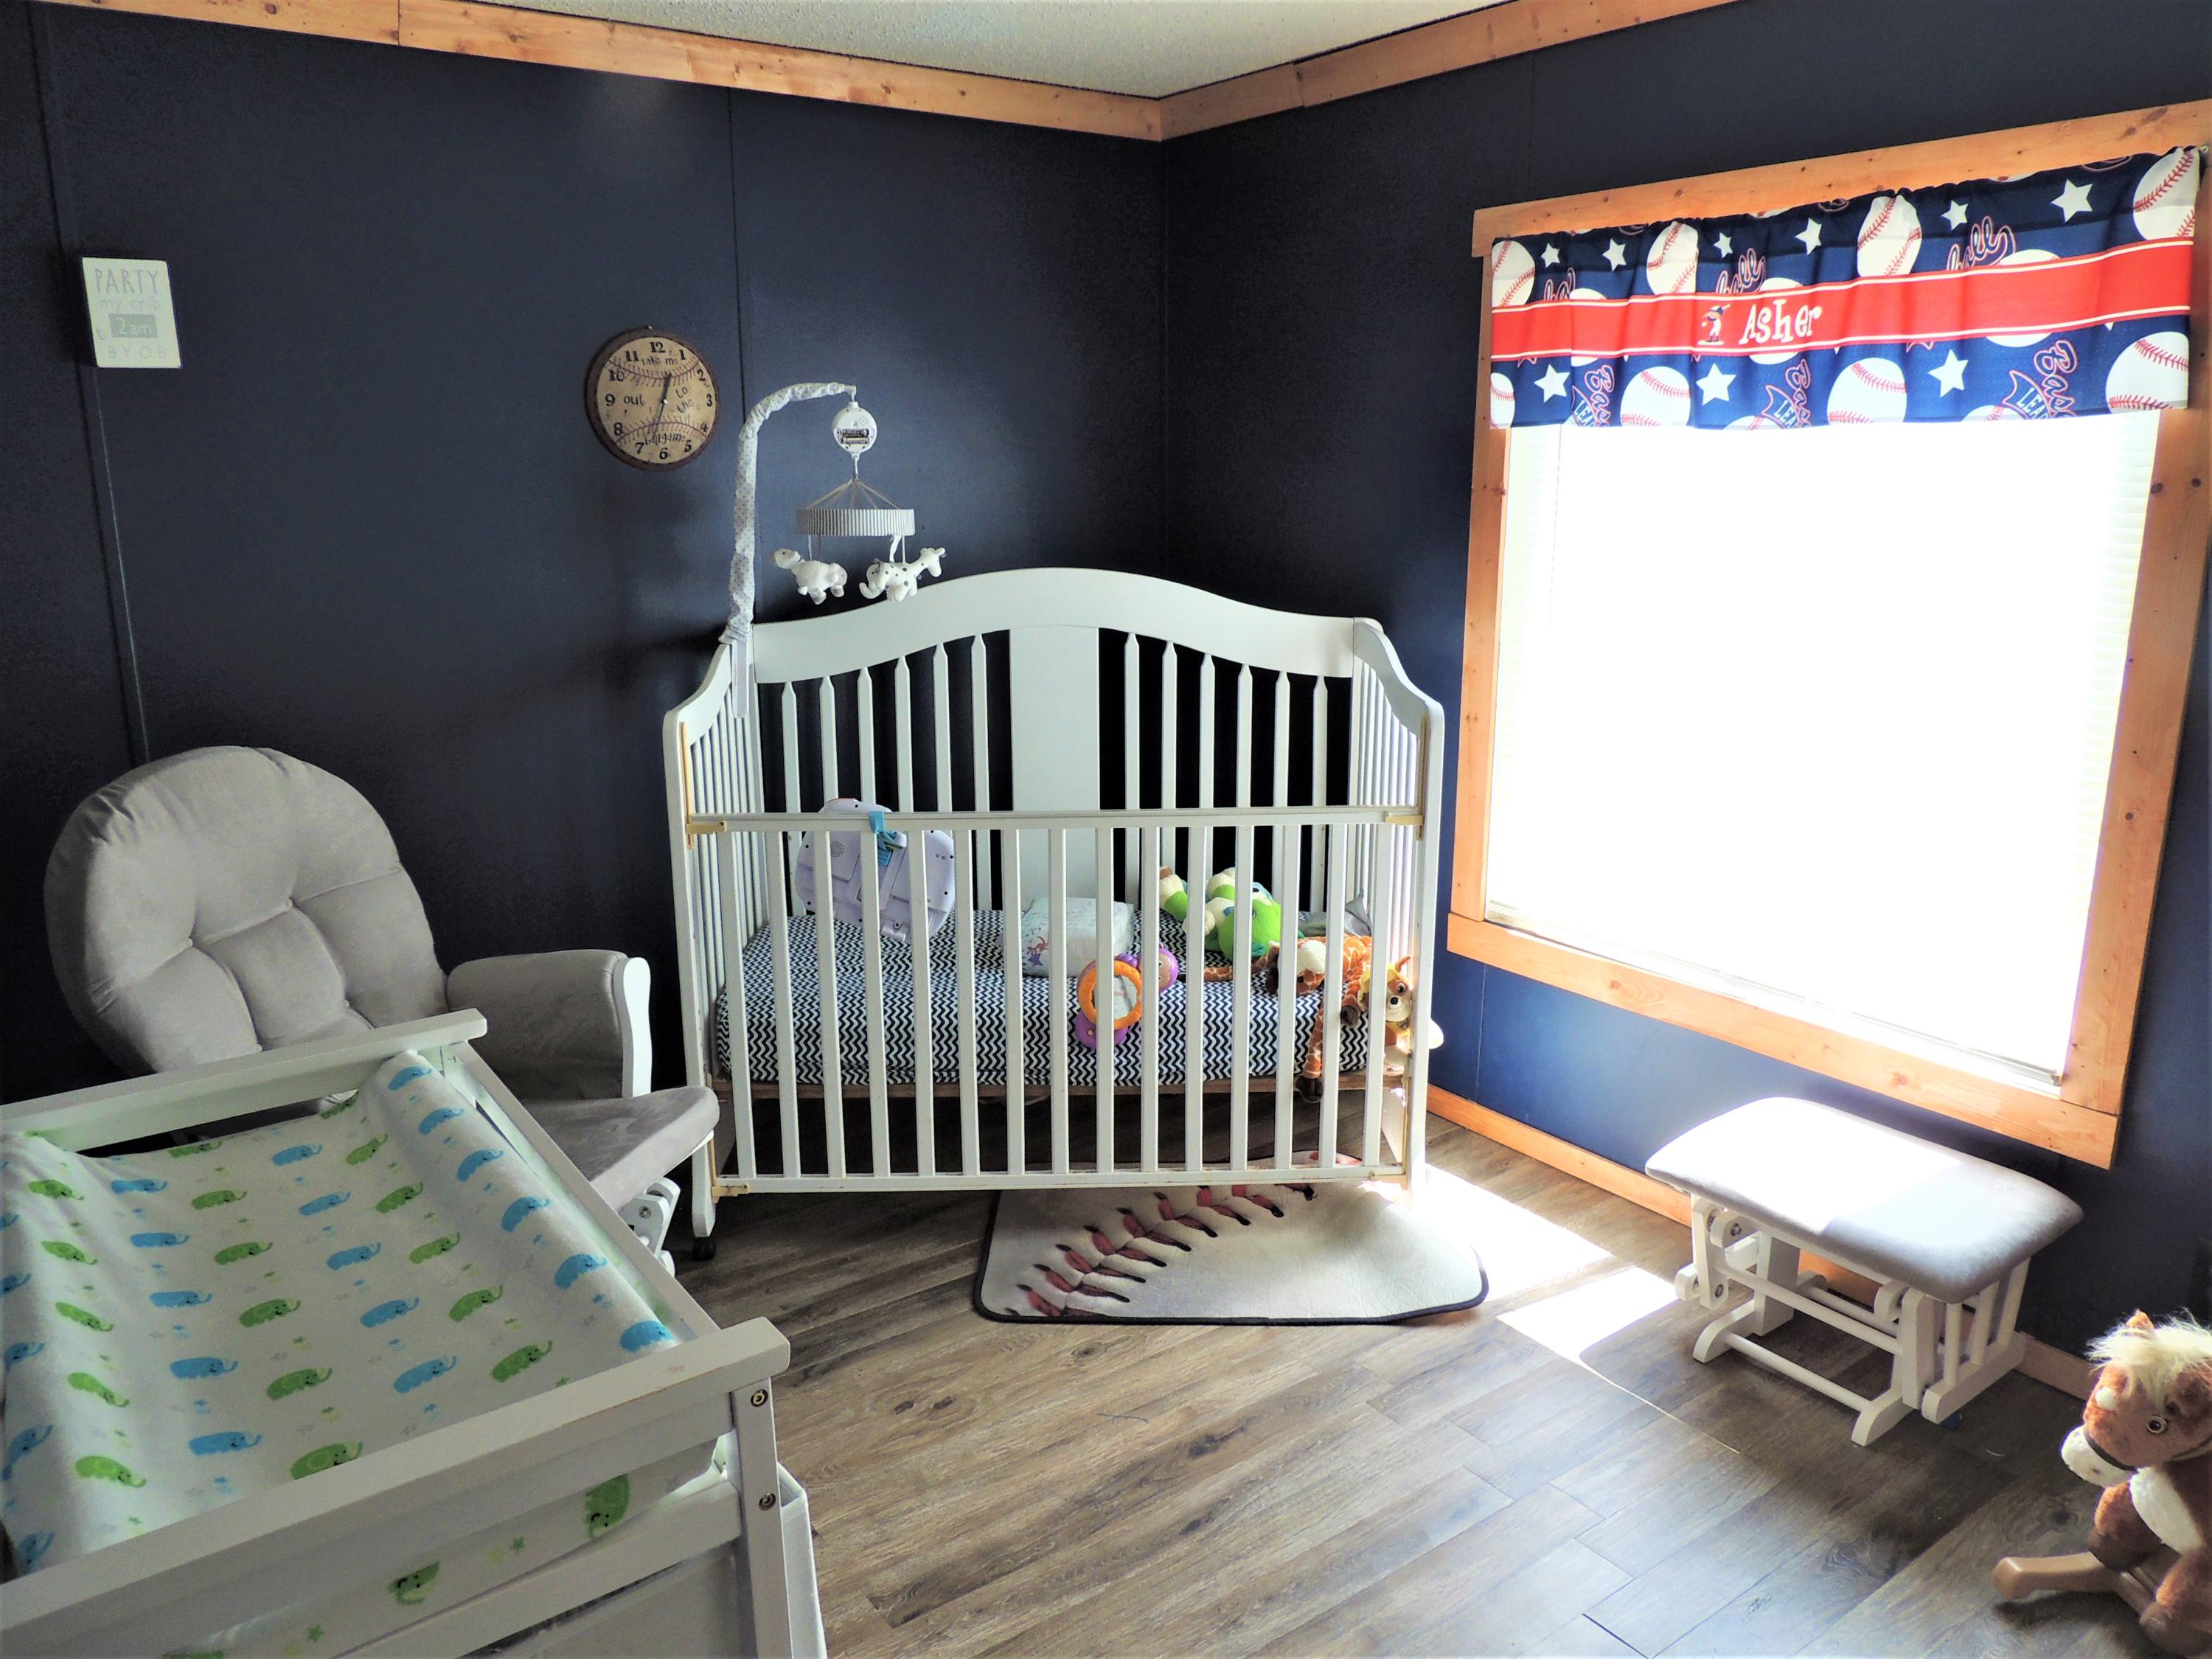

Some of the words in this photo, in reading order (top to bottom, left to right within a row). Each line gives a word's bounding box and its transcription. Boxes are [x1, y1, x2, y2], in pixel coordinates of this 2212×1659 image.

[94, 268, 159, 294] PARTY
[100, 299, 123, 313] my
[115, 317, 153, 335] 2am
[1738, 299, 1822, 345] Asher
[108, 345, 167, 360] BYOB
[650, 341, 666, 353] 12
[625, 350, 639, 362] 11
[641, 355, 661, 367] take
[665, 357, 678, 366] me
[678, 349, 686, 361] 1
[609, 369, 625, 382] 10
[697, 369, 706, 381] 2
[675, 386, 688, 398] to
[605, 394, 616, 406] 9
[624, 394, 645, 406] out
[676, 399, 695, 414] the
[706, 393, 713, 407] 3
[2016, 387, 2049, 420] LEA
[613, 422, 623, 437] 8
[700, 421, 709, 433] 4
[635, 442, 644, 454] 7
[684, 439, 692, 453] 5
[659, 447, 668, 460] 6
